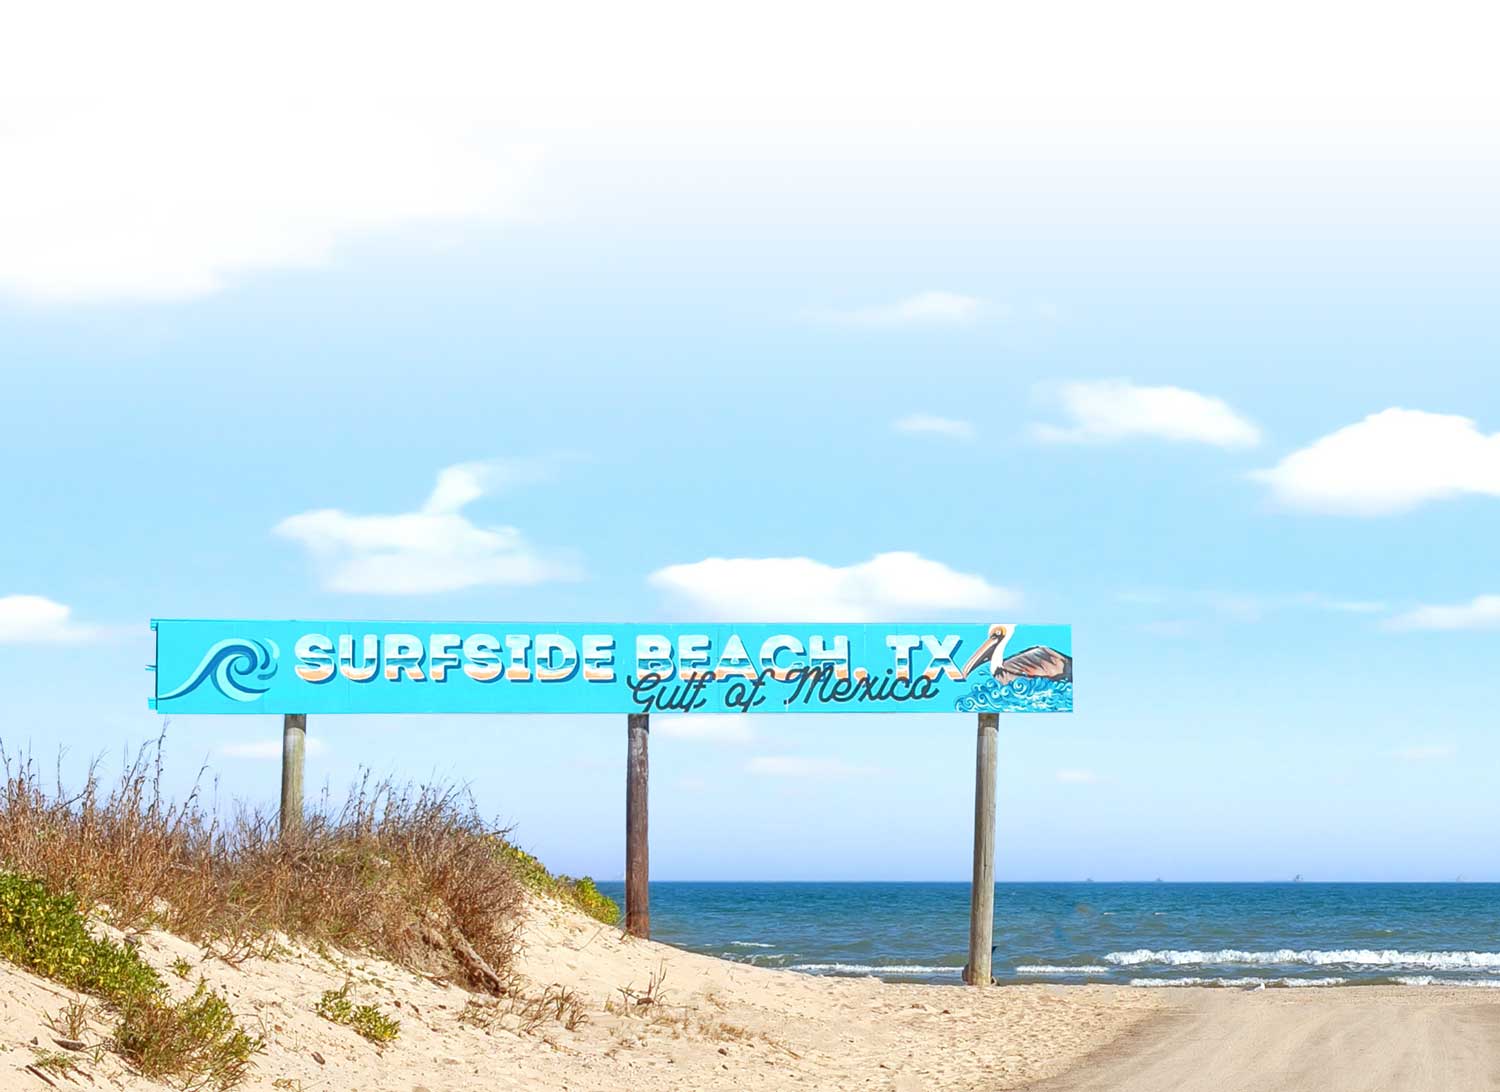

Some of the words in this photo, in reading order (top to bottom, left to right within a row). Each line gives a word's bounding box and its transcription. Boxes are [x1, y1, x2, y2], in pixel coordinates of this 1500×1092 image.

[294, 633, 616, 683] SURFSIDE
[886, 634, 966, 683] TX
[627, 669, 718, 713] Gulf
[724, 668, 775, 713] of
[783, 666, 940, 705] Mexico
